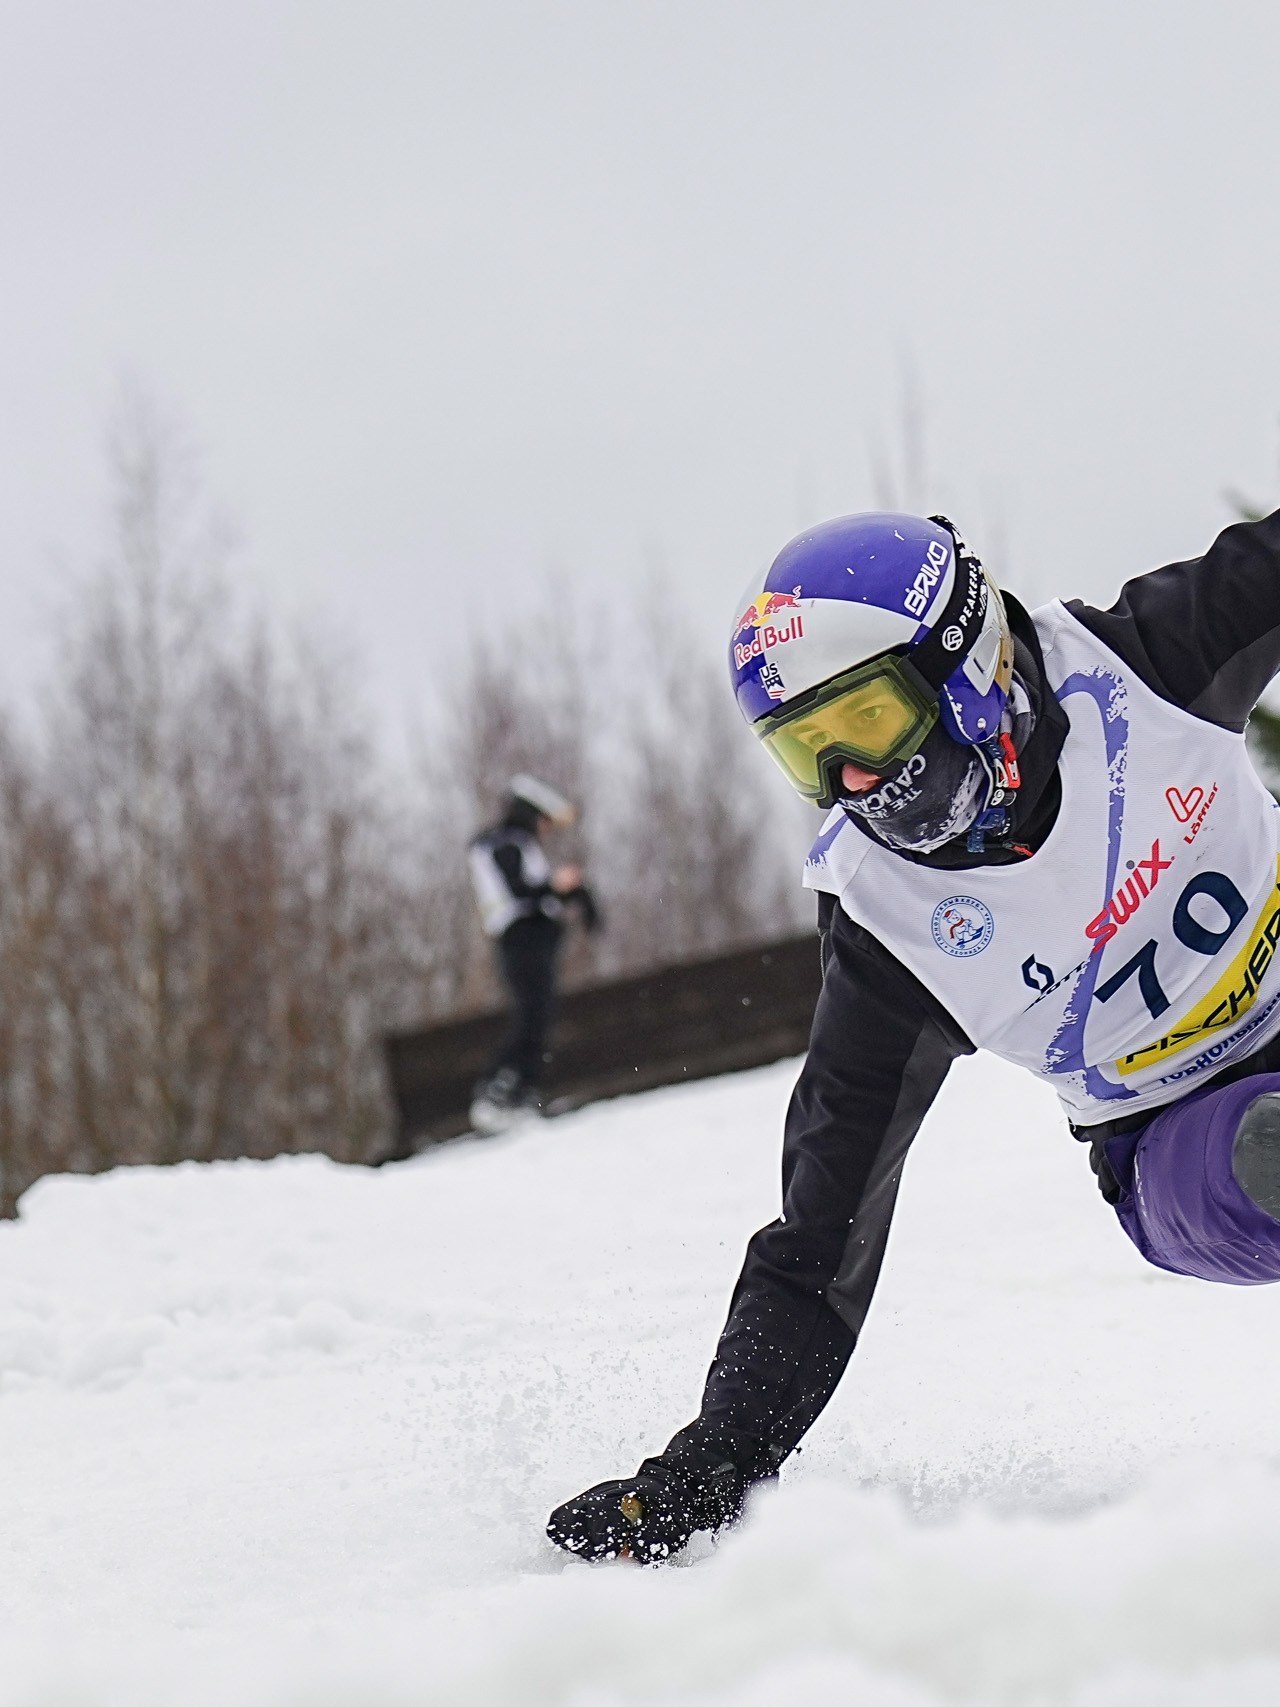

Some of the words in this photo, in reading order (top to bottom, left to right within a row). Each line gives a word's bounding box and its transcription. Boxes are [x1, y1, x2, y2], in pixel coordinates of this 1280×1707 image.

[903, 540, 948, 617] BRIKO
[959, 562, 978, 627] PEAKERS
[735, 630, 763, 669] Red
[764, 615, 804, 649] Bull
[760, 662, 778, 679] US
[1093, 871, 1249, 1020] 70
